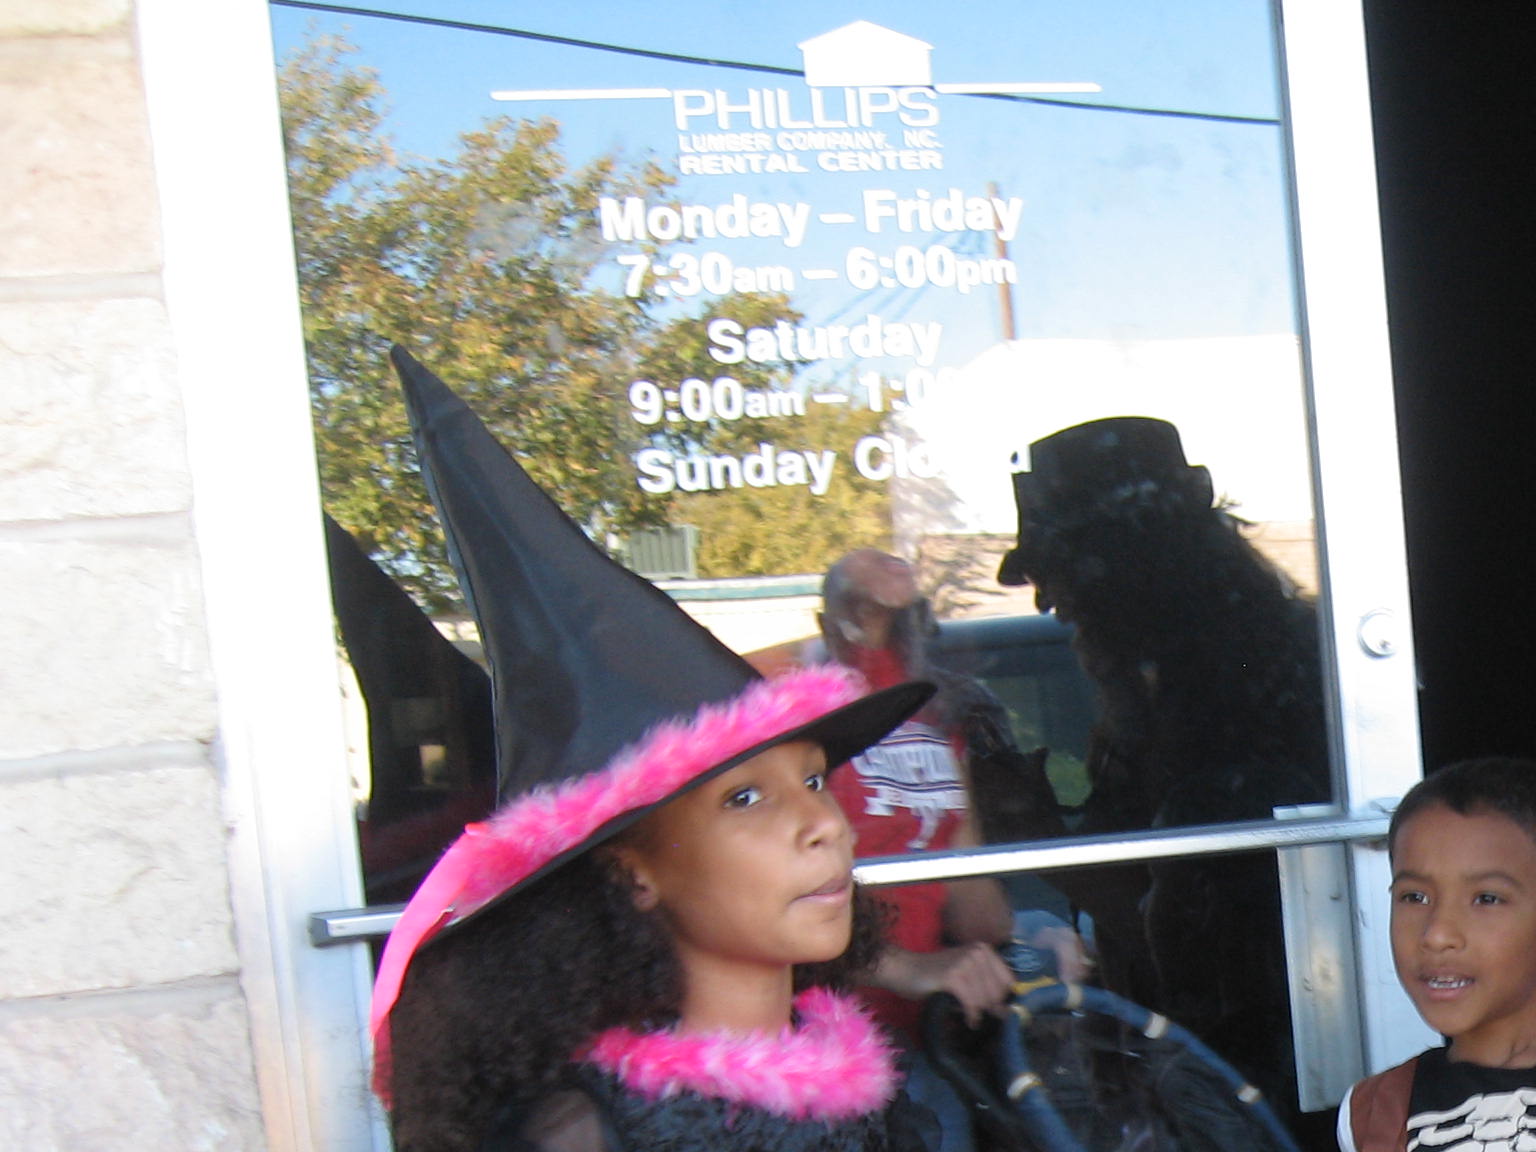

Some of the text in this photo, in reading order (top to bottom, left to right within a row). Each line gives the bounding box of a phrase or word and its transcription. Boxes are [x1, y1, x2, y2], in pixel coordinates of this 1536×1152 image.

[673, 87, 939, 129] PHILLIPS
[679, 132, 771, 152] LUMBER
[680, 150, 944, 175] RENTAL CENTER
[601, 194, 811, 247] Monday
[863, 188, 1022, 241] Friday
[617, 251, 795, 298] 7:30am
[846, 245, 1018, 293] 6:00pm
[706, 314, 943, 366] Saturday
[629, 376, 805, 425] 9:00am
[636, 441, 837, 496] Sunday
